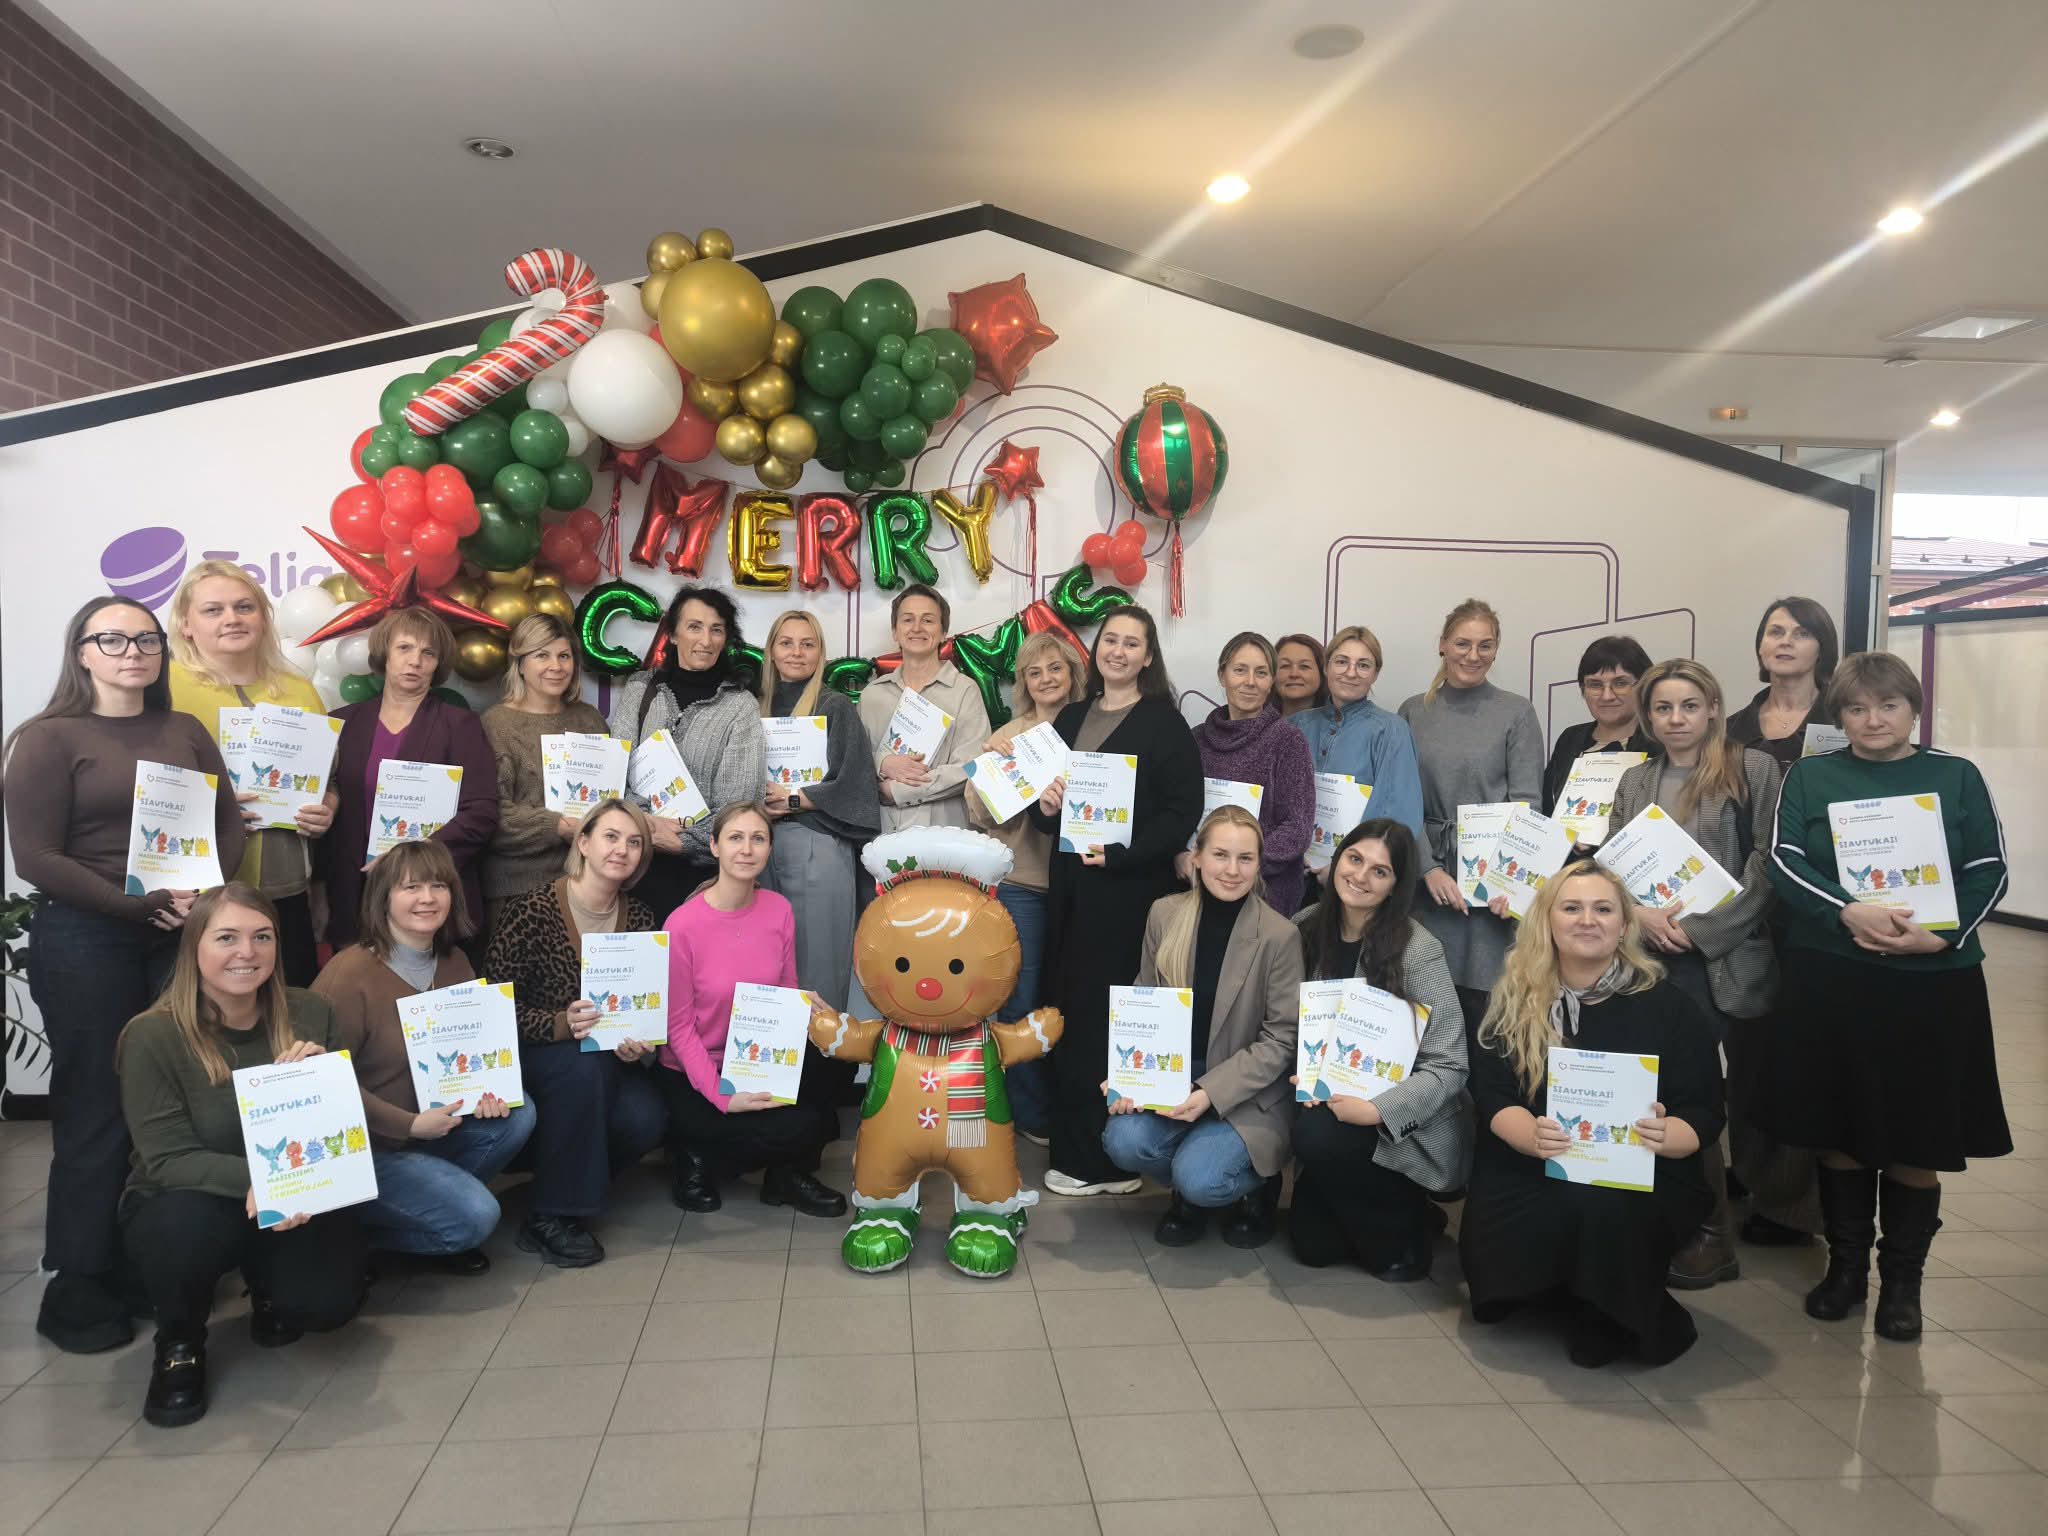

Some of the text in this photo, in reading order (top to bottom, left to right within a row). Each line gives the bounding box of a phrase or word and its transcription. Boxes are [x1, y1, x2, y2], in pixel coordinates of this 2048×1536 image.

[629, 460, 1001, 592] MERRY
[1839, 835, 1898, 849] SIAUTUKAI!
[1552, 1085, 1614, 1099] SIAUTUKAI!
[248, 1094, 322, 1119] SIAUTUKAI!
